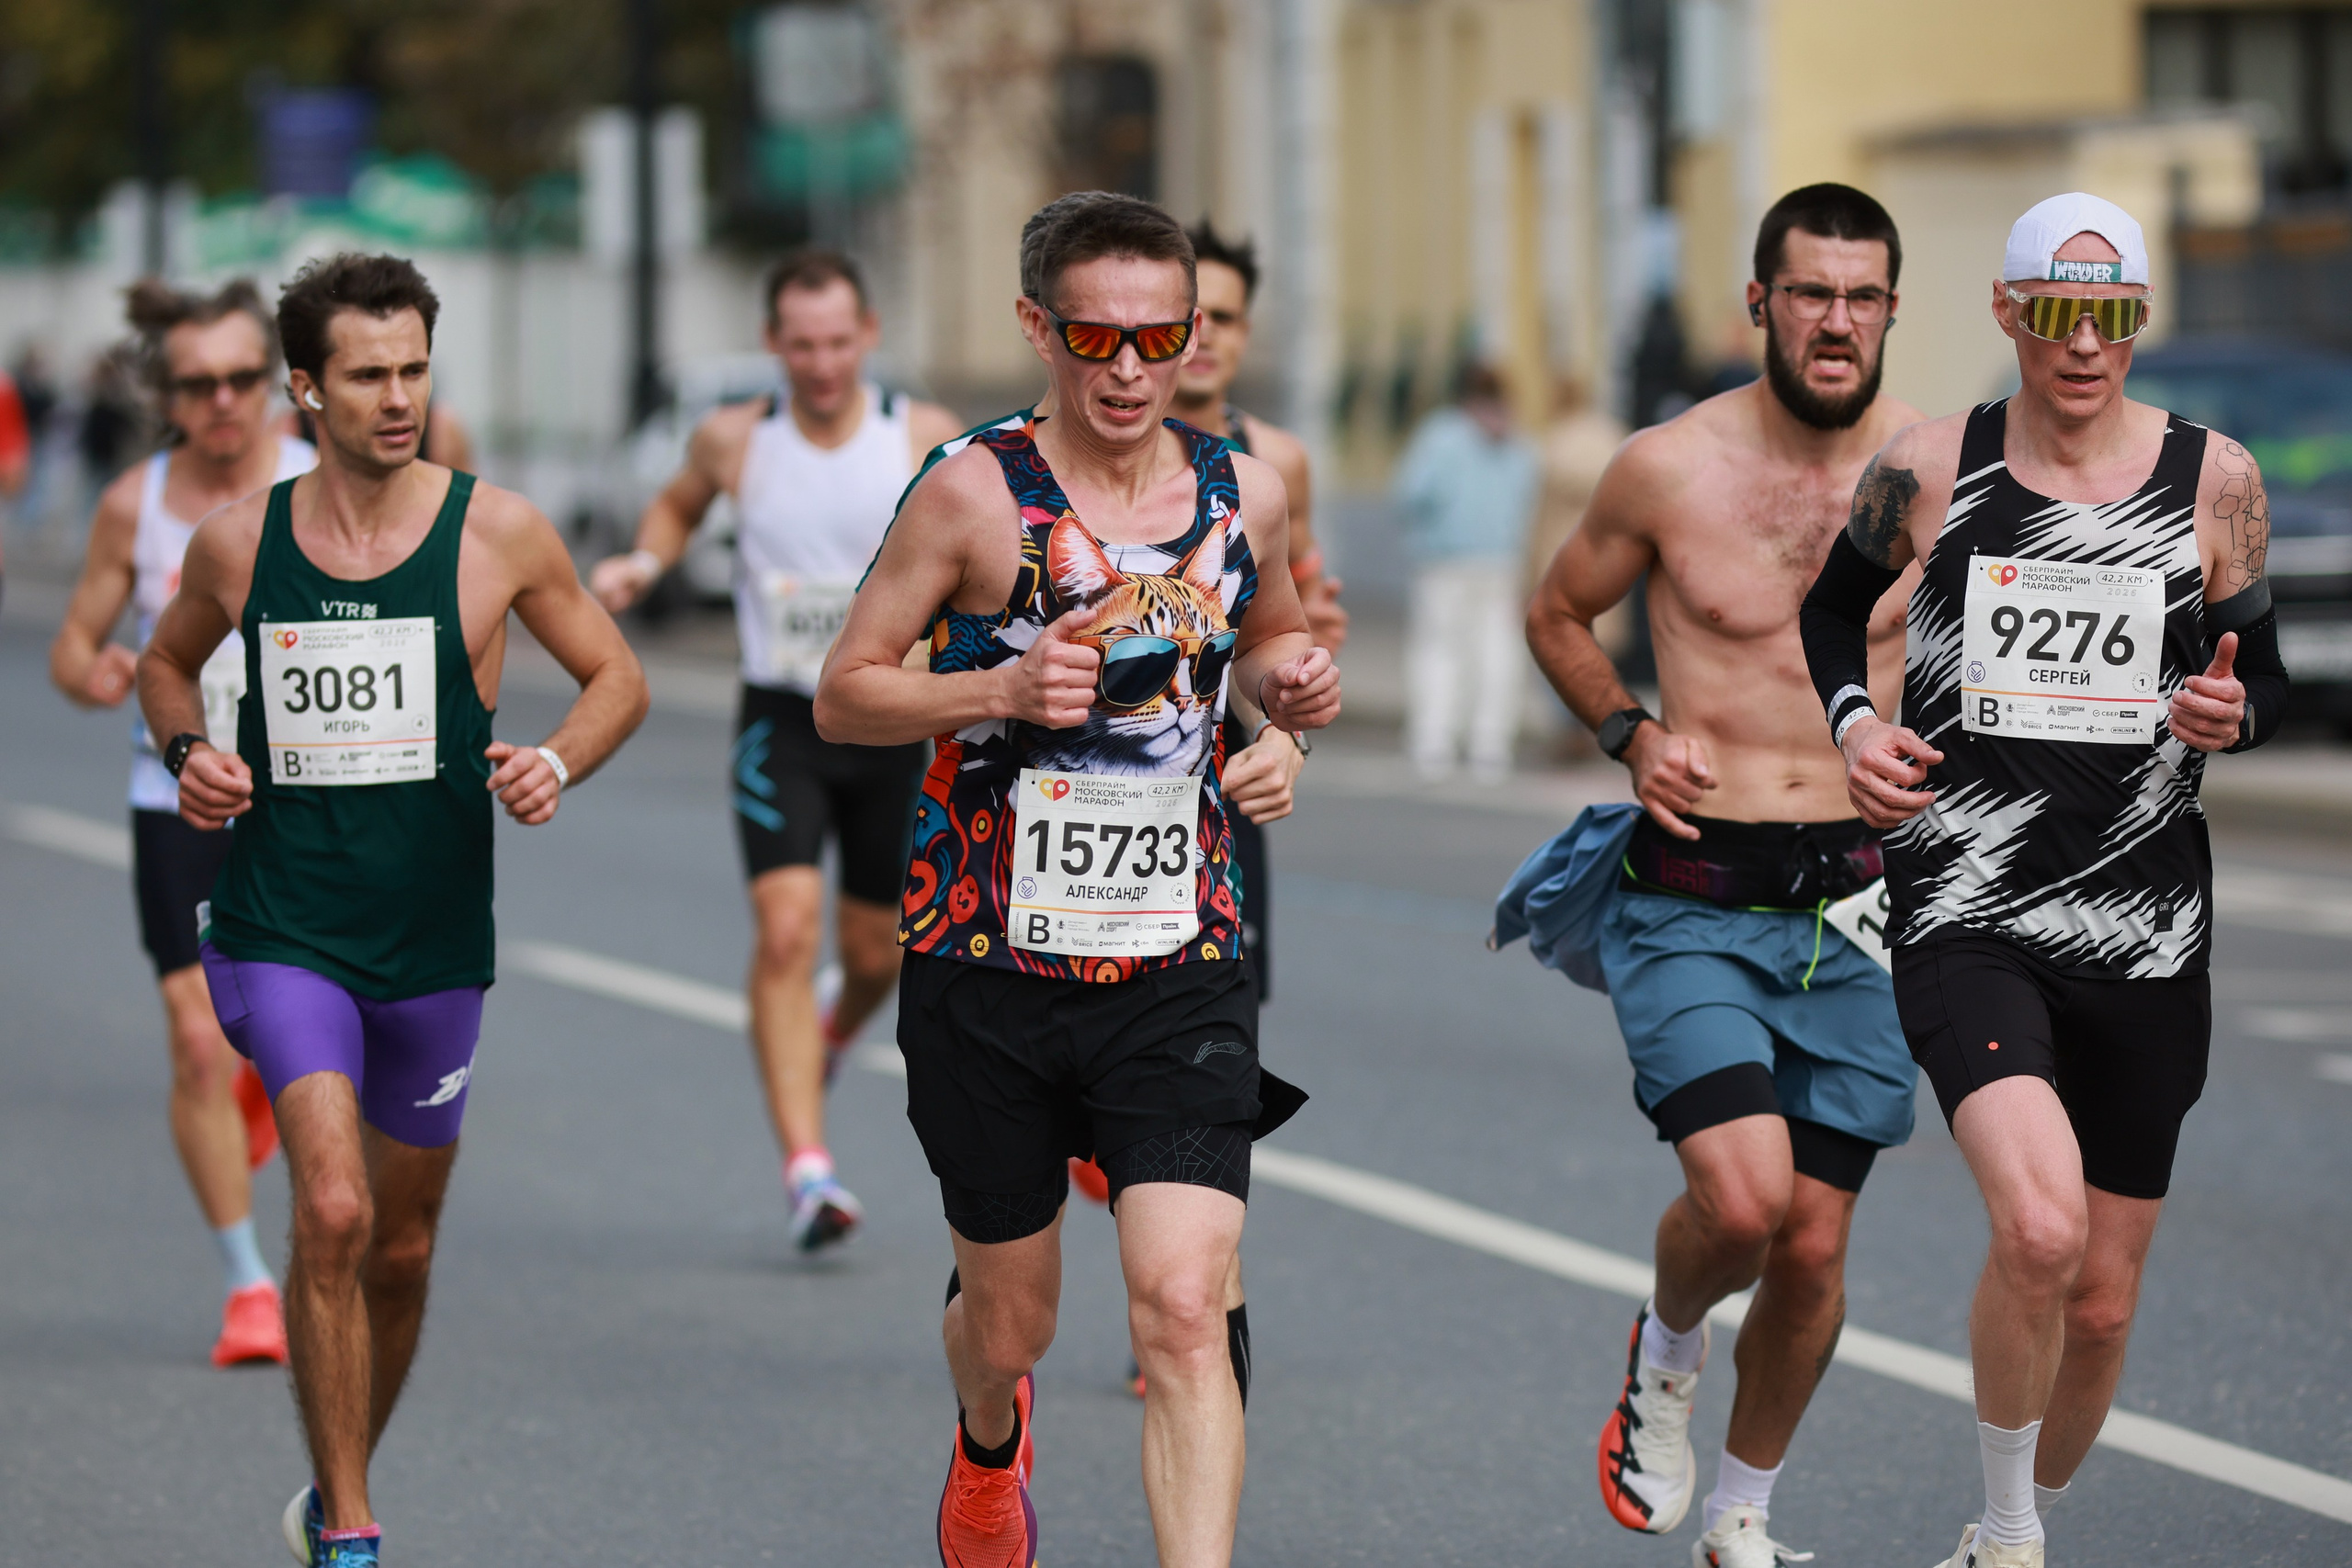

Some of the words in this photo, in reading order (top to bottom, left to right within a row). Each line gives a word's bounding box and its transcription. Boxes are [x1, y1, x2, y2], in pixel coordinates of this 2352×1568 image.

[2024, 565, 2074, 575] СБЕРПРАЙМ
[2023, 574, 2090, 585] МОСКОВСКИЙ
[2102, 575, 2124, 584] 42,2
[2022, 583, 2072, 592] МАРАФОН
[303, 633, 364, 642] МОСКОВСКИЙ
[1990, 605, 2135, 666] 9276
[303, 642, 349, 650] МАРАФОН
[2029, 669, 2091, 686] СЕРГЕЙ
[2139, 678, 2145, 687] 1
[282, 663, 403, 713] 3081
[324, 720, 370, 733] ИГОРЬ
[1075, 780, 1126, 789] СБЕРПРАЙМ
[1075, 788, 1142, 799] МОСКОВСКИЙ
[1152, 786, 1170, 795] 42,2
[1074, 796, 1125, 807] МАРАФОН
[1027, 819, 1189, 878] 15733
[1066, 884, 1148, 902] АЛЕКСАНДР
[1176, 889, 1183, 897] 4
